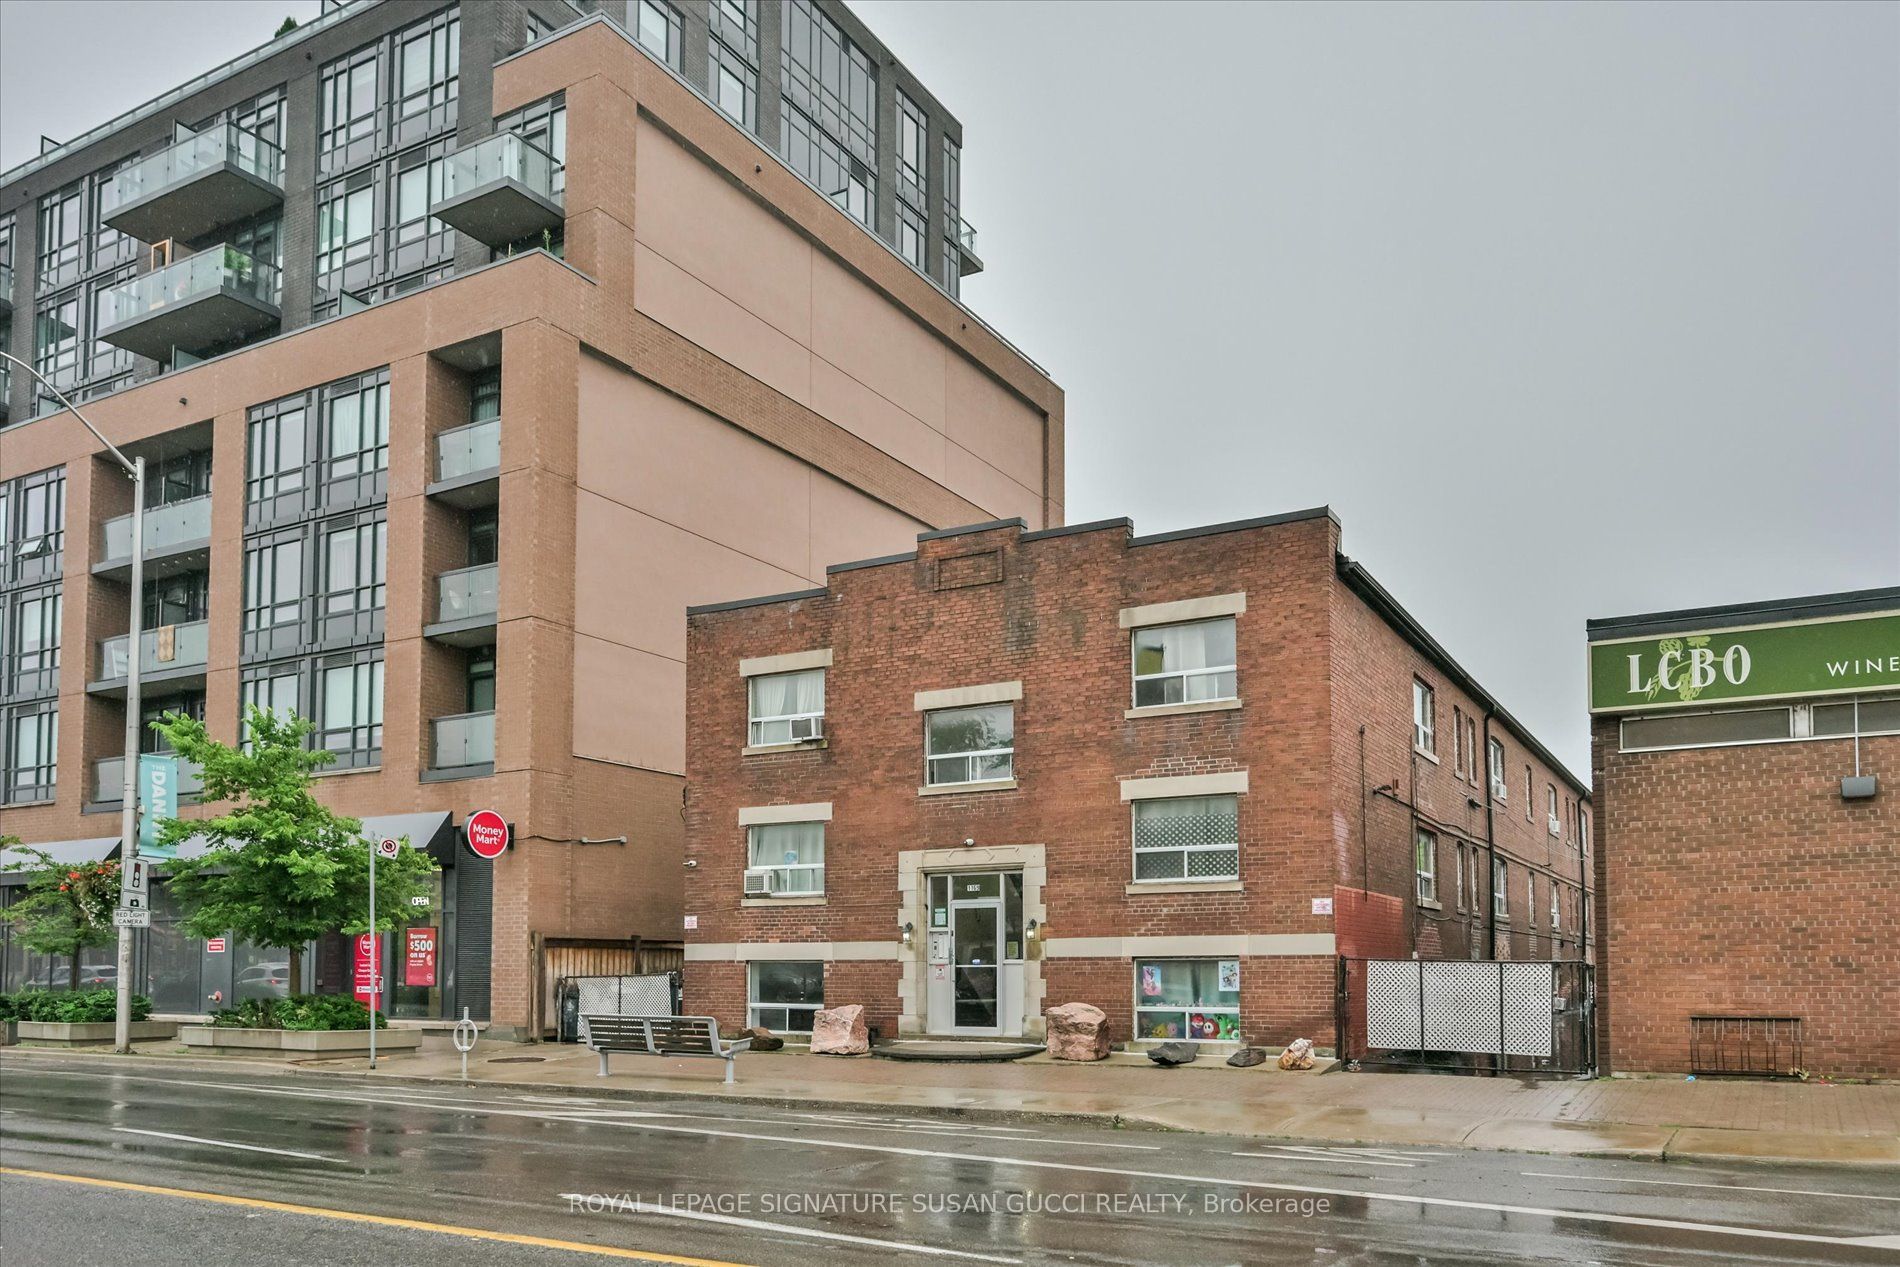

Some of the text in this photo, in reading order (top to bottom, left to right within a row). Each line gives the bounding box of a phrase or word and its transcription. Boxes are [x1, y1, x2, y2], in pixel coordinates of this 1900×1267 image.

[1626, 644, 1751, 694] LCBO
[472, 823, 504, 838] Money
[476, 834, 498, 845] Mart
[412, 897, 429, 905] OPEN
[410, 940, 433, 951] $500
